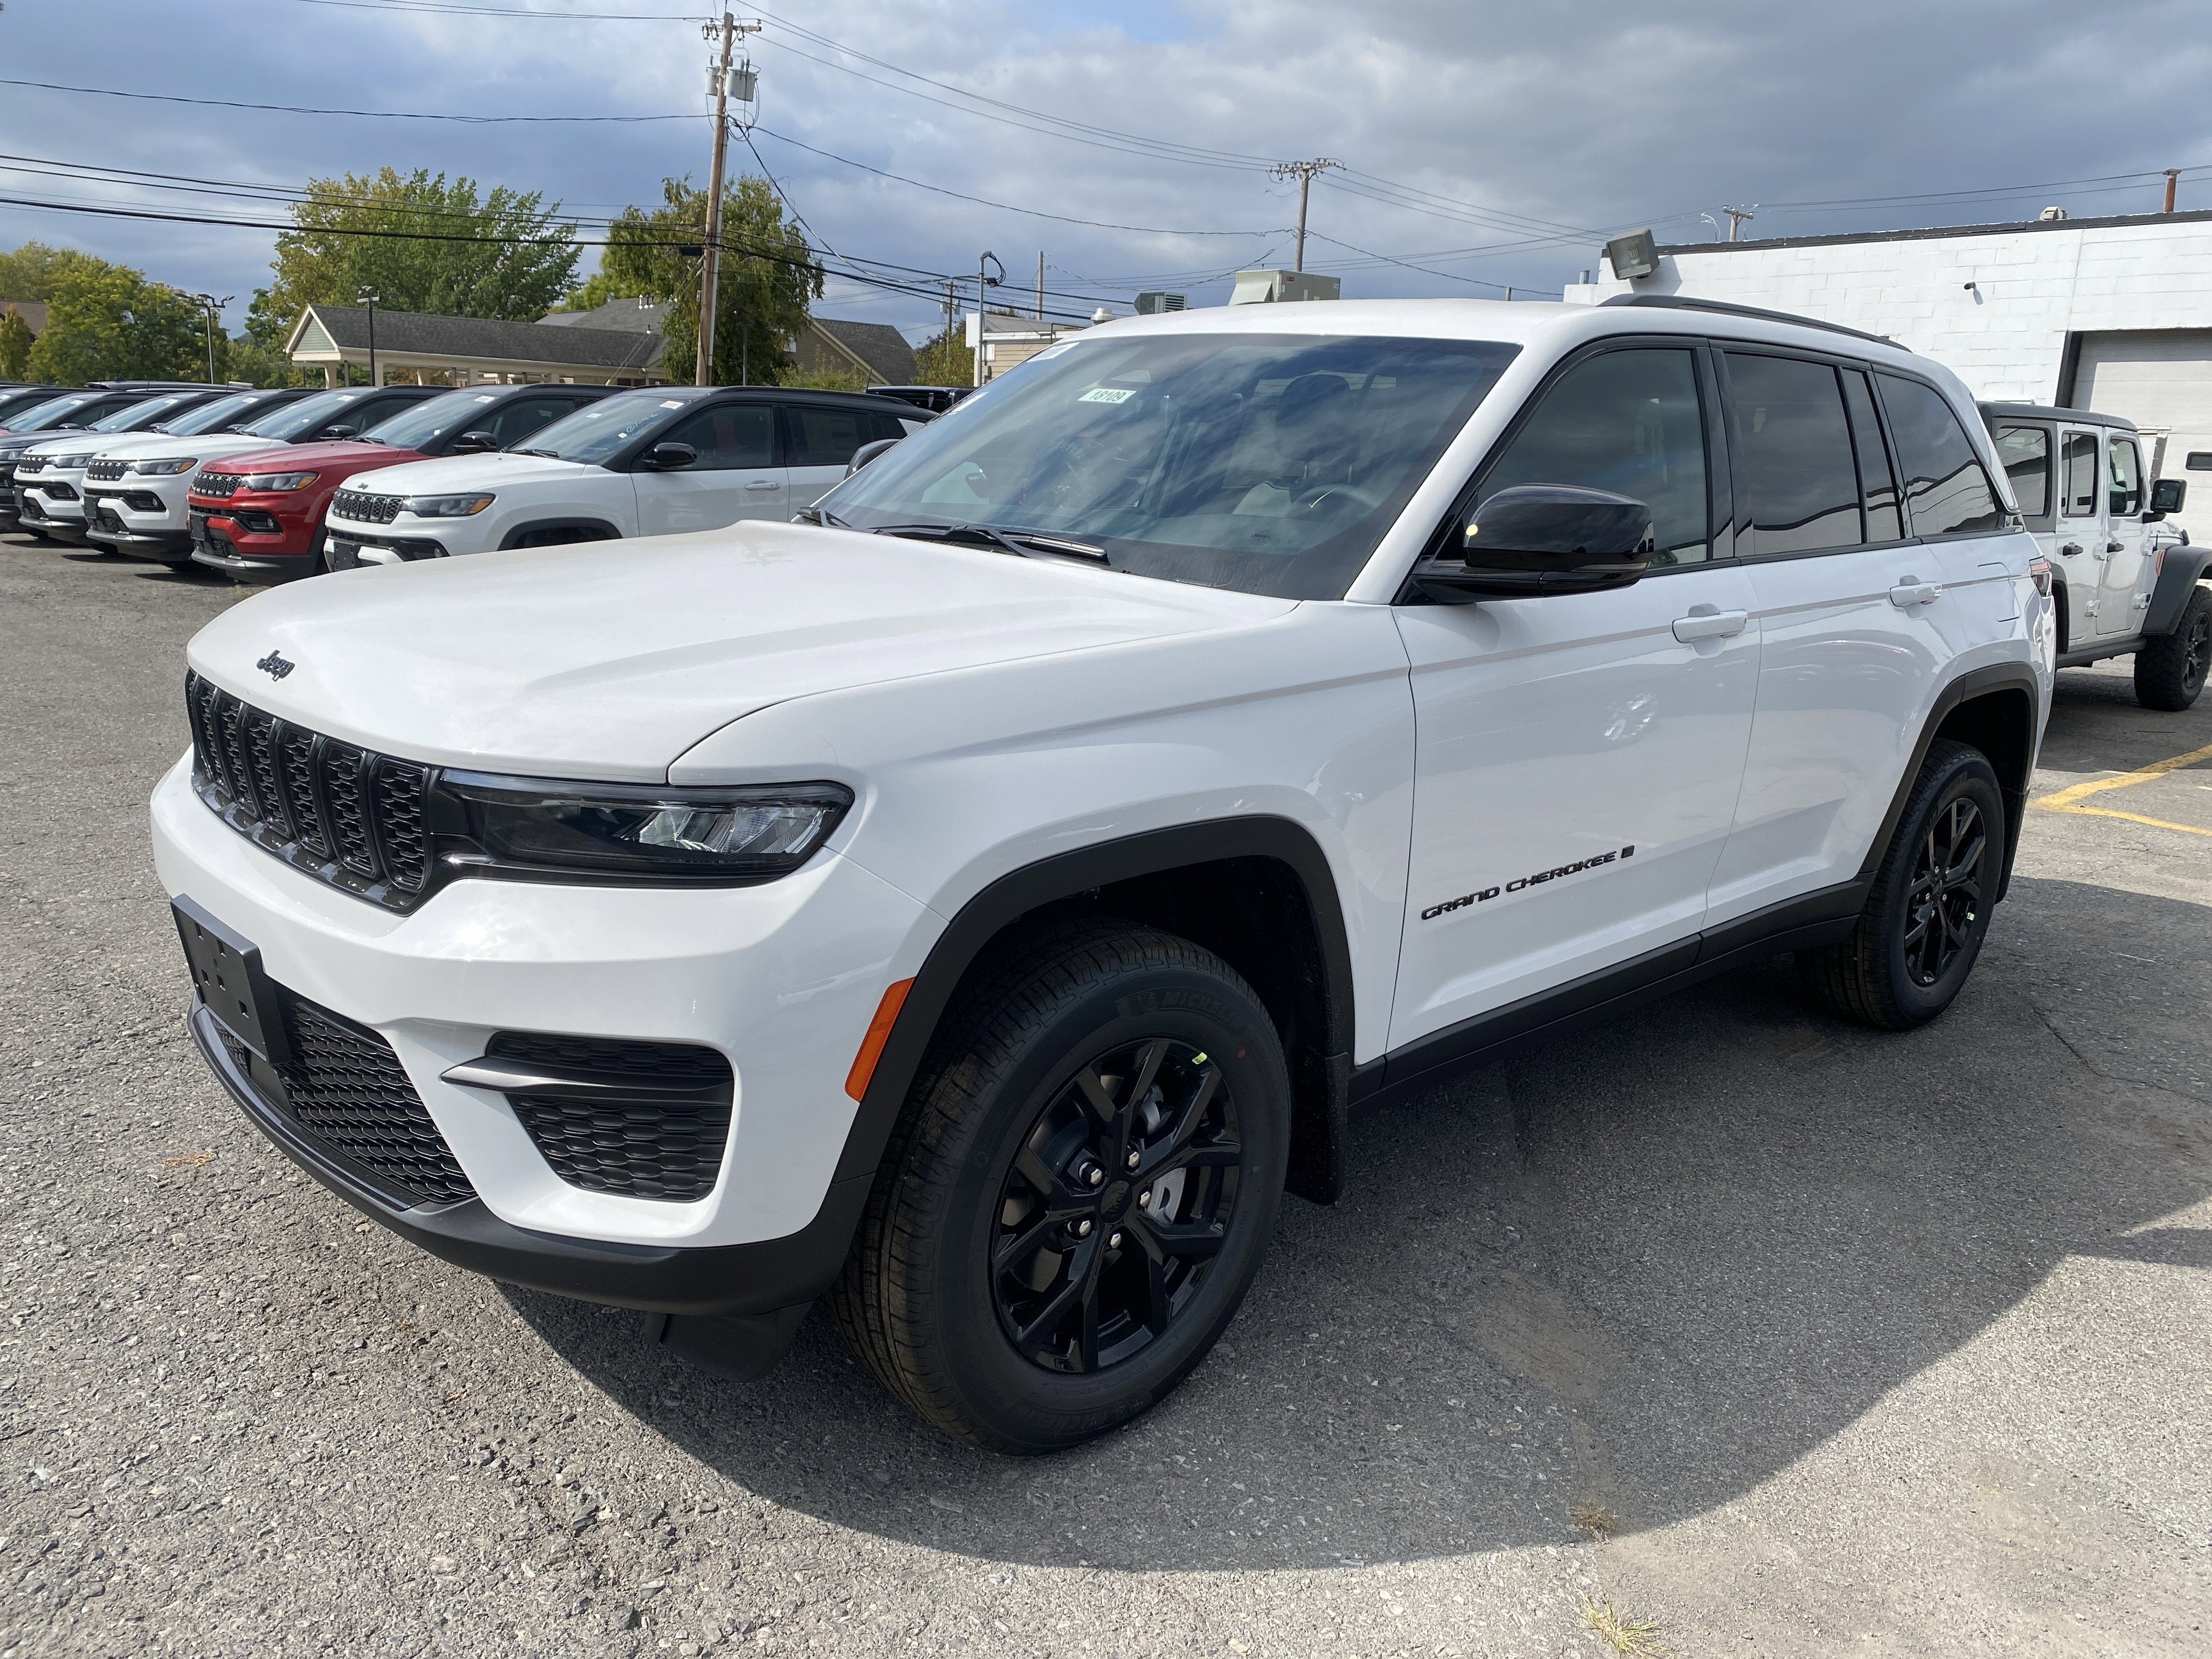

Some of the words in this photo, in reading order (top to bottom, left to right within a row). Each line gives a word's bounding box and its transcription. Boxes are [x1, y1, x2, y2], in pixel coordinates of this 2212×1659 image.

[1089, 390, 1126, 401] 18109
[256, 649, 295, 681] Jeep
[1421, 886, 1500, 921] GRAND
[1506, 851, 1617, 893] CHEROKEE
